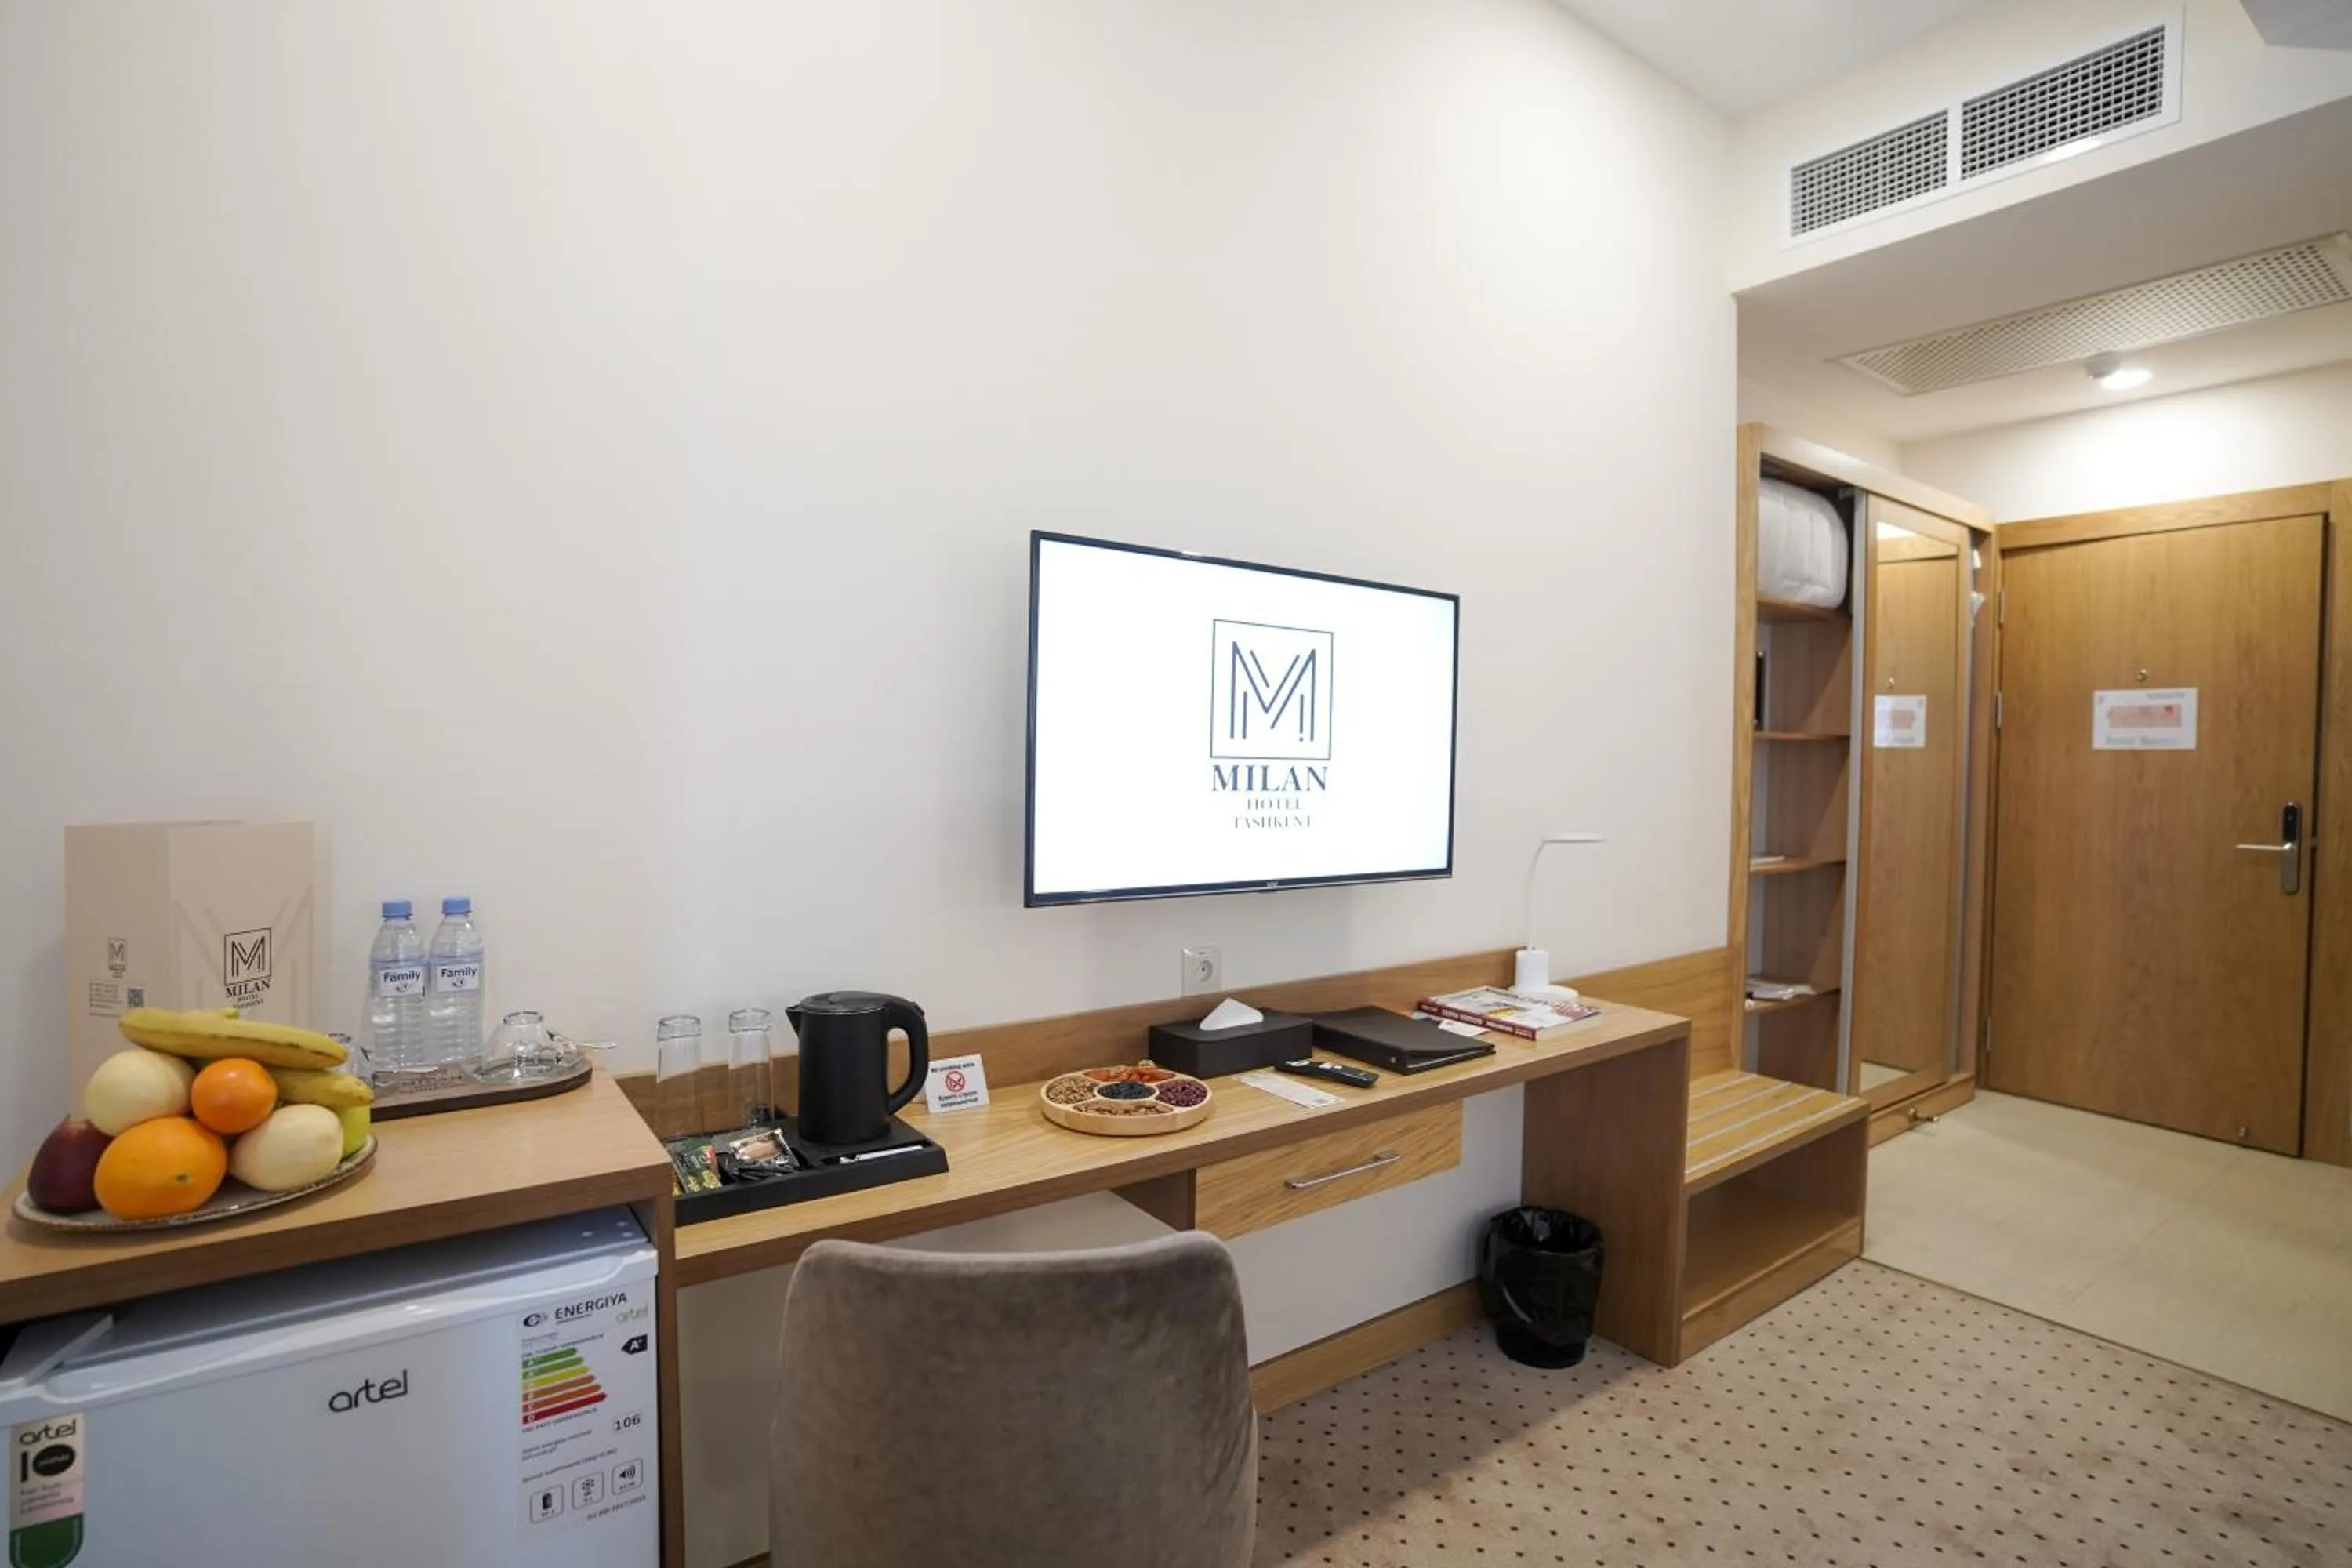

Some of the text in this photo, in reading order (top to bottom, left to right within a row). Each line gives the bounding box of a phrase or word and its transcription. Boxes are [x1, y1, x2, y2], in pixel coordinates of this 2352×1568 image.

[1211, 764, 1328, 792] MILAN
[1247, 797, 1305, 811] HOTEL
[1233, 815, 1314, 829] TASHKENT
[383, 970, 421, 982] Family
[441, 966, 477, 978] Family
[225, 978, 271, 999] MILAN
[554, 1292, 627, 1320] ENERGIYA
[328, 1368, 408, 1413] artel
[19, 1418, 77, 1446] artel
[615, 1413, 641, 1432] 106
